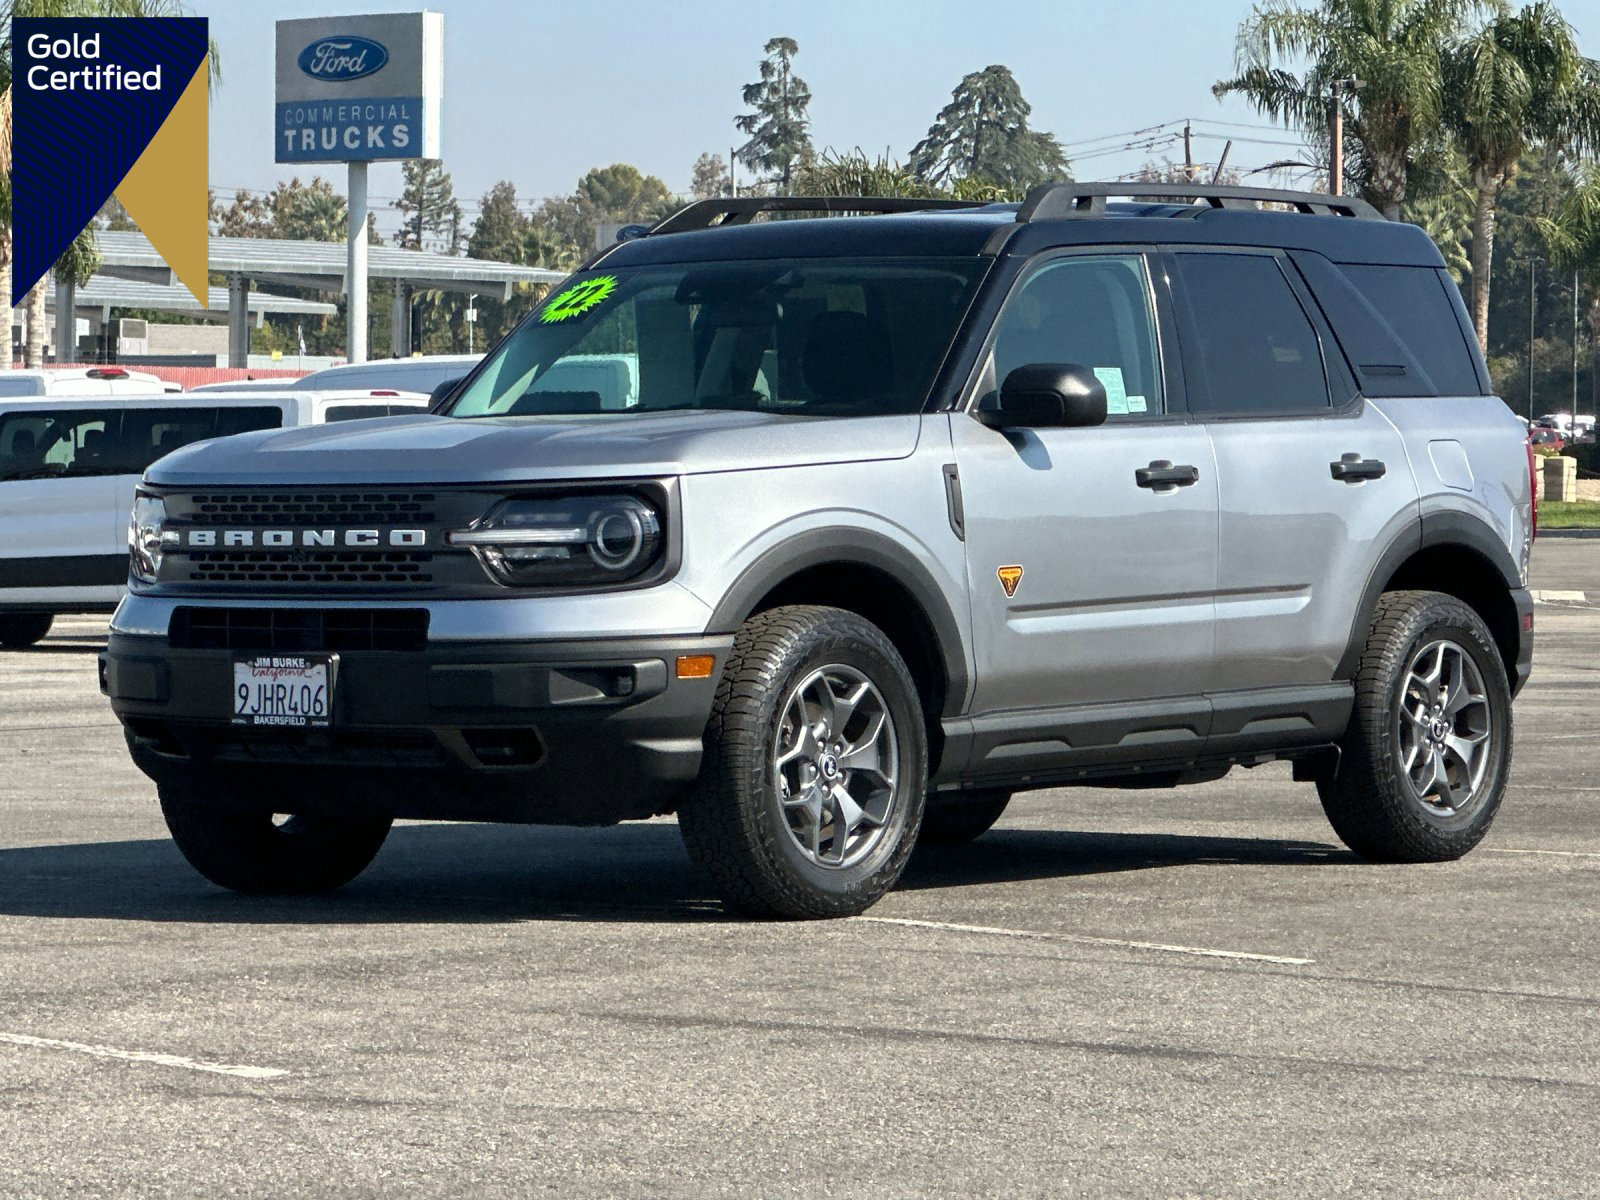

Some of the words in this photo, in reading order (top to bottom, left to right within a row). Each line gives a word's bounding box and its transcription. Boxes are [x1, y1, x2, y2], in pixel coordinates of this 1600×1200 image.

[311, 42, 368, 74] Ford
[285, 104, 410, 125] COMMERCIAL
[284, 124, 409, 151] TRUCKS
[188, 529, 426, 546] BRONCO
[254, 657, 271, 667] JIM
[272, 657, 305, 668] BURKE
[238, 683, 325, 715] 9JHR406
[254, 715, 306, 725] BAKERSFIELD
